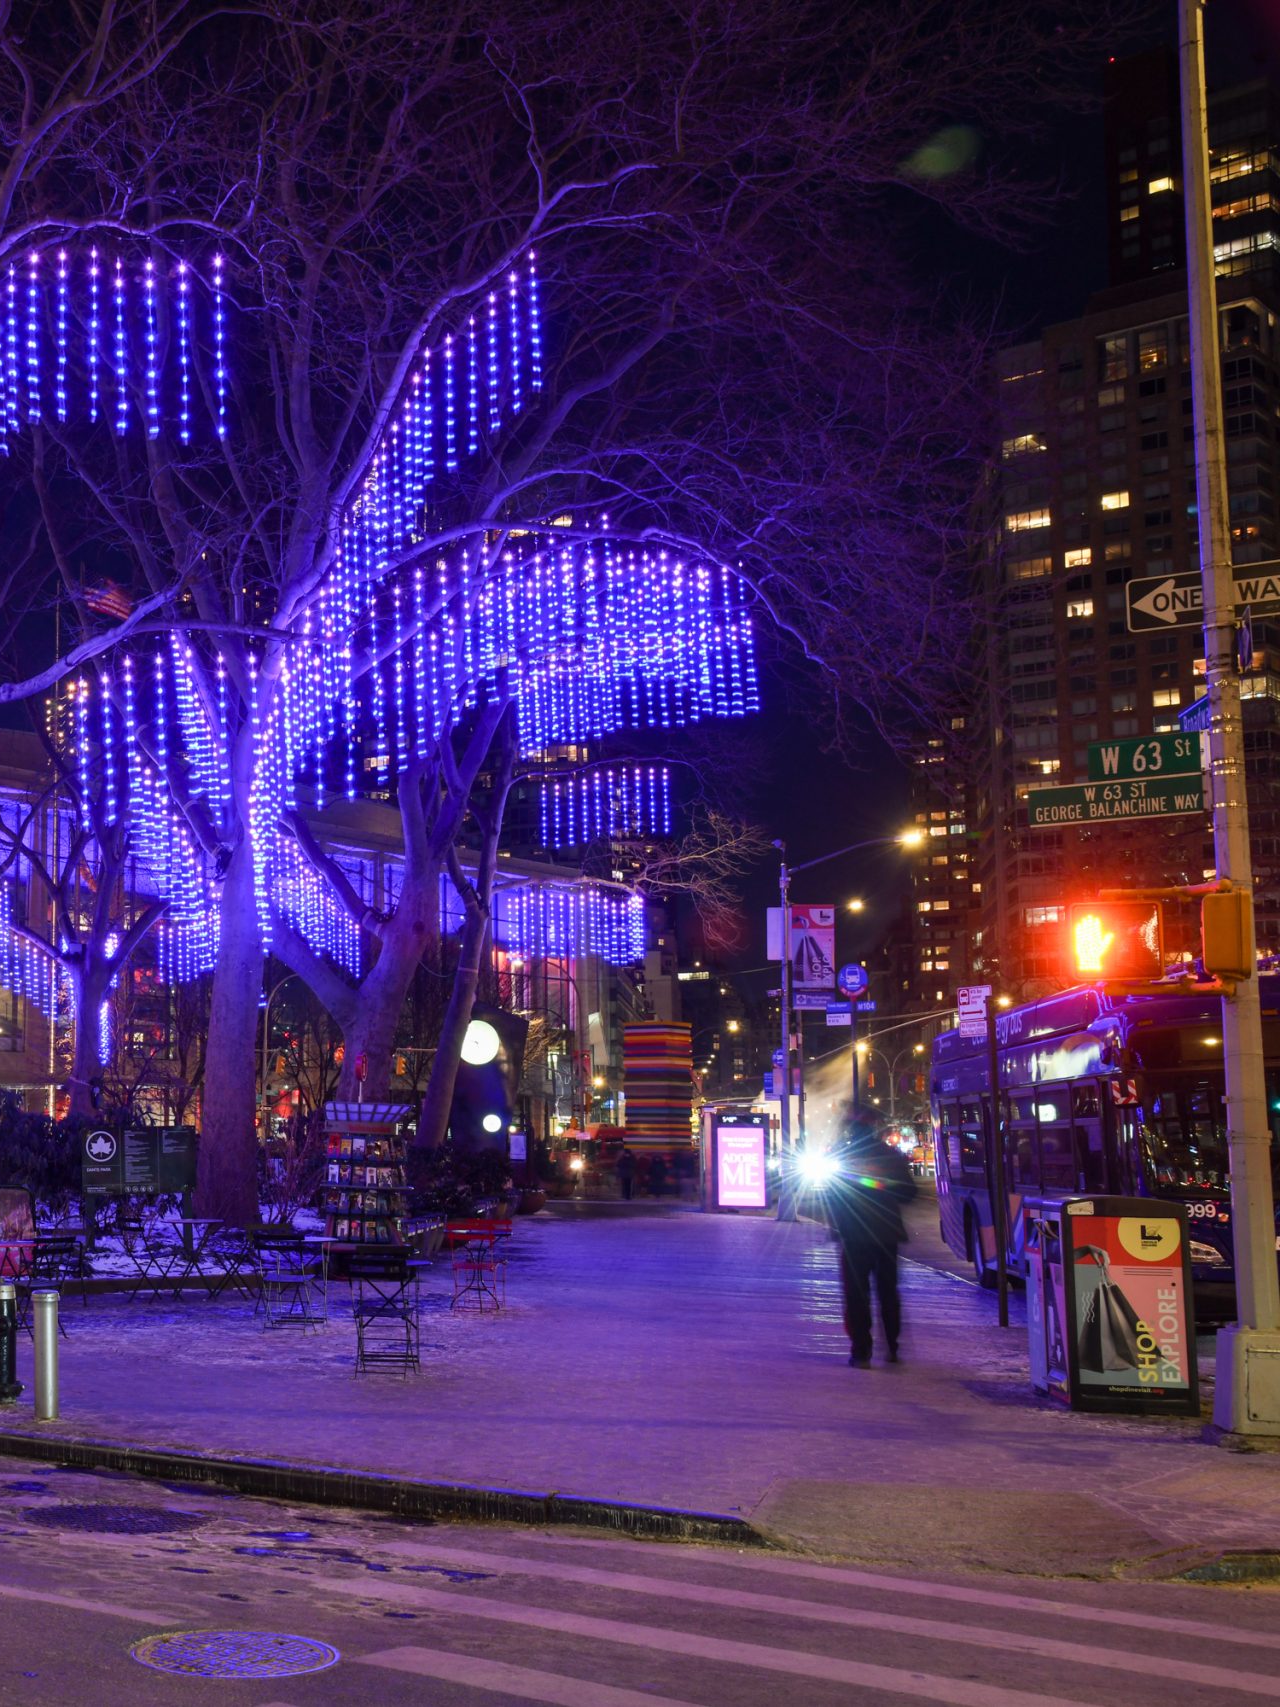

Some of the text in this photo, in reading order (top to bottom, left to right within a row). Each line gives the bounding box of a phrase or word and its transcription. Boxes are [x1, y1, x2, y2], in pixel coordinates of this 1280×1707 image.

[1152, 576, 1280, 613] ONE WA
[1183, 705, 1209, 731] Broadwa
[1101, 738, 1191, 775] W 63 St
[1084, 781, 1147, 802] W 63 ST
[1035, 793, 1200, 823] GEORGE BALANCHINE WAY
[858, 1002, 875, 1010] M104
[723, 1162, 760, 1186] ME
[1136, 1320, 1158, 1383] SHOP
